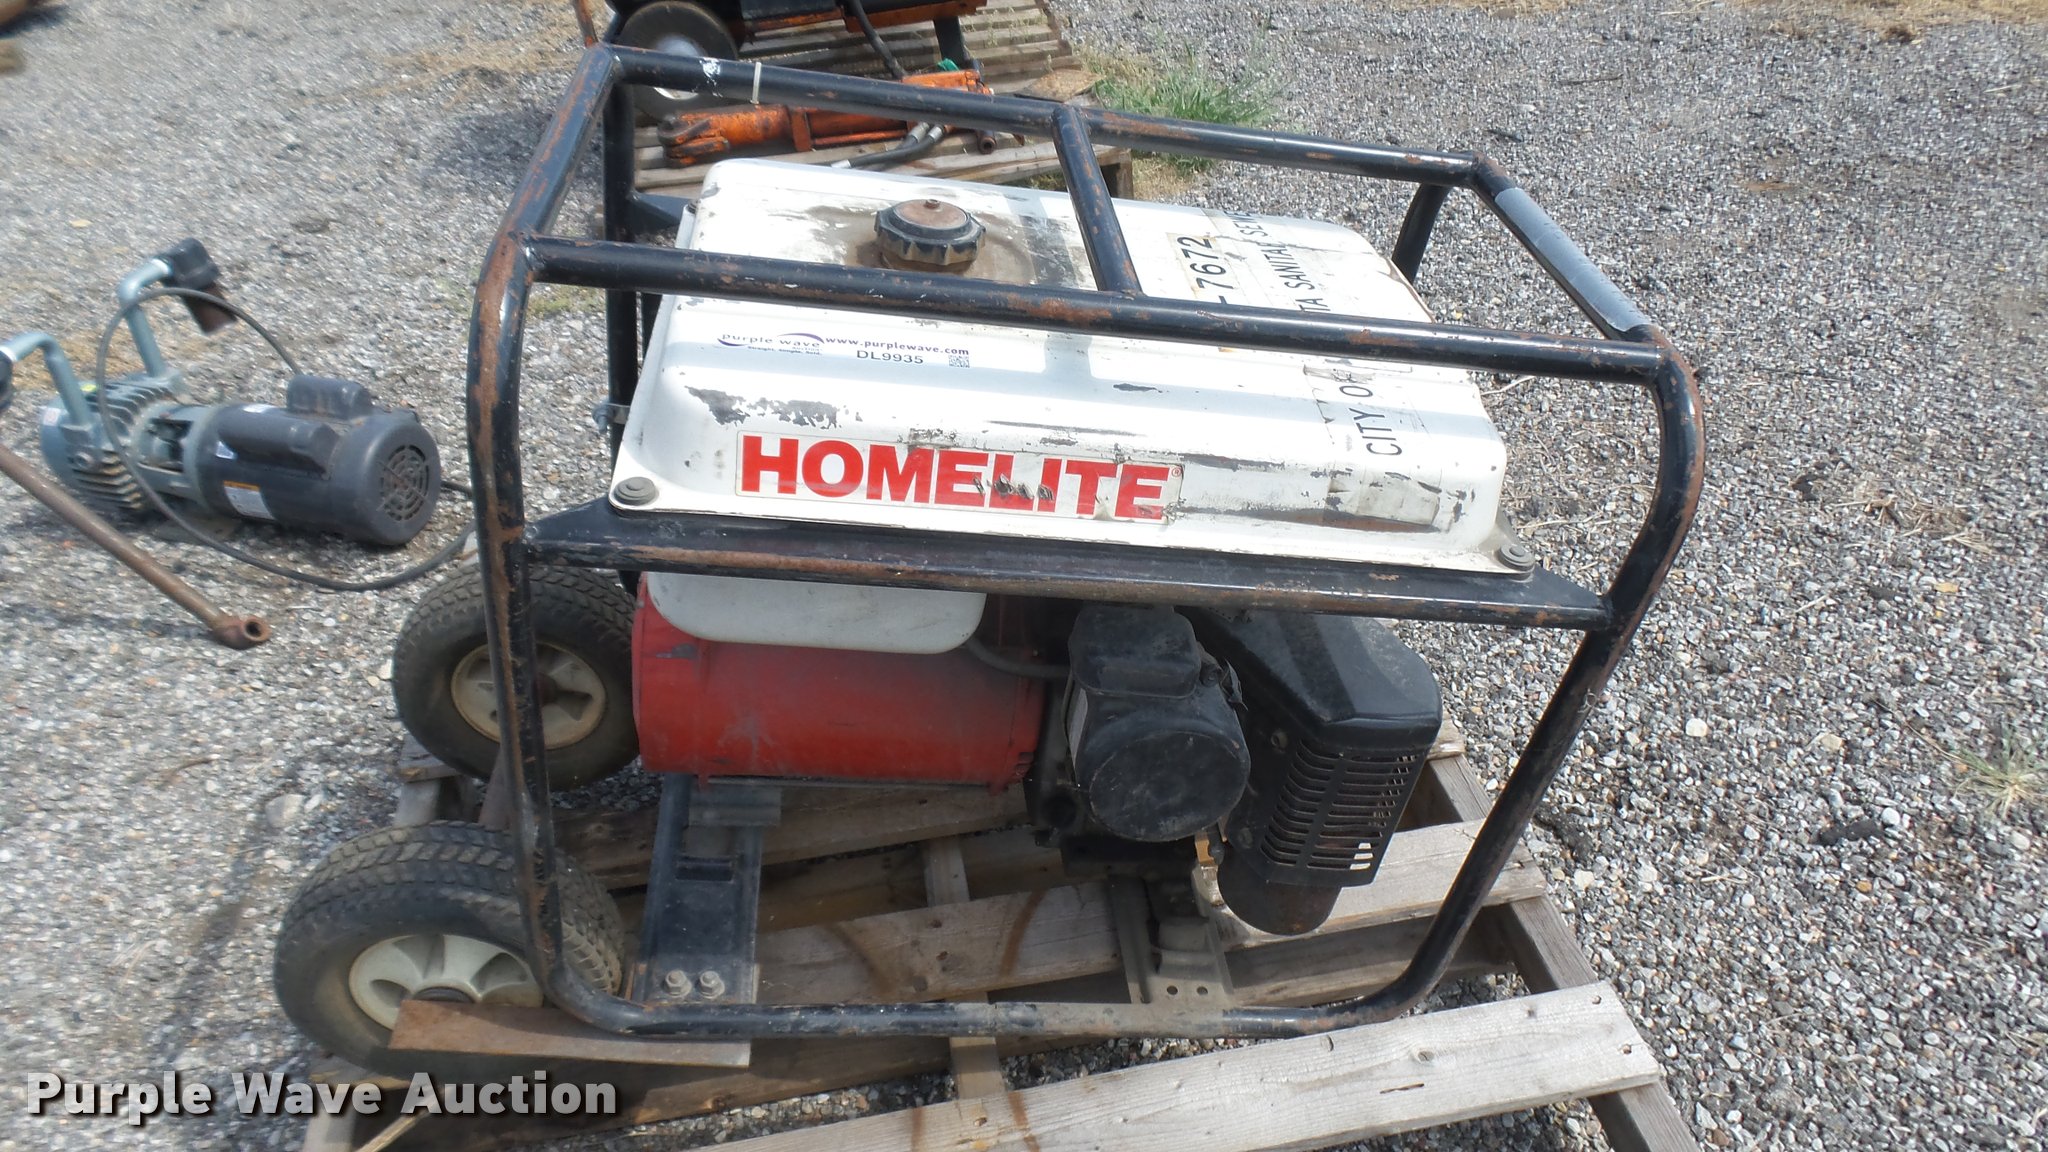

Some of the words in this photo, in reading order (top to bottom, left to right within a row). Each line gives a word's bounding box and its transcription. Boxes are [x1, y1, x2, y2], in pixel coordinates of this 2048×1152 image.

[825, 337, 969, 356] www.purplewave.com
[856, 350, 924, 364] DL9935
[1348, 407, 1403, 456] CITY
[742, 435, 1171, 520] HOMELITE
